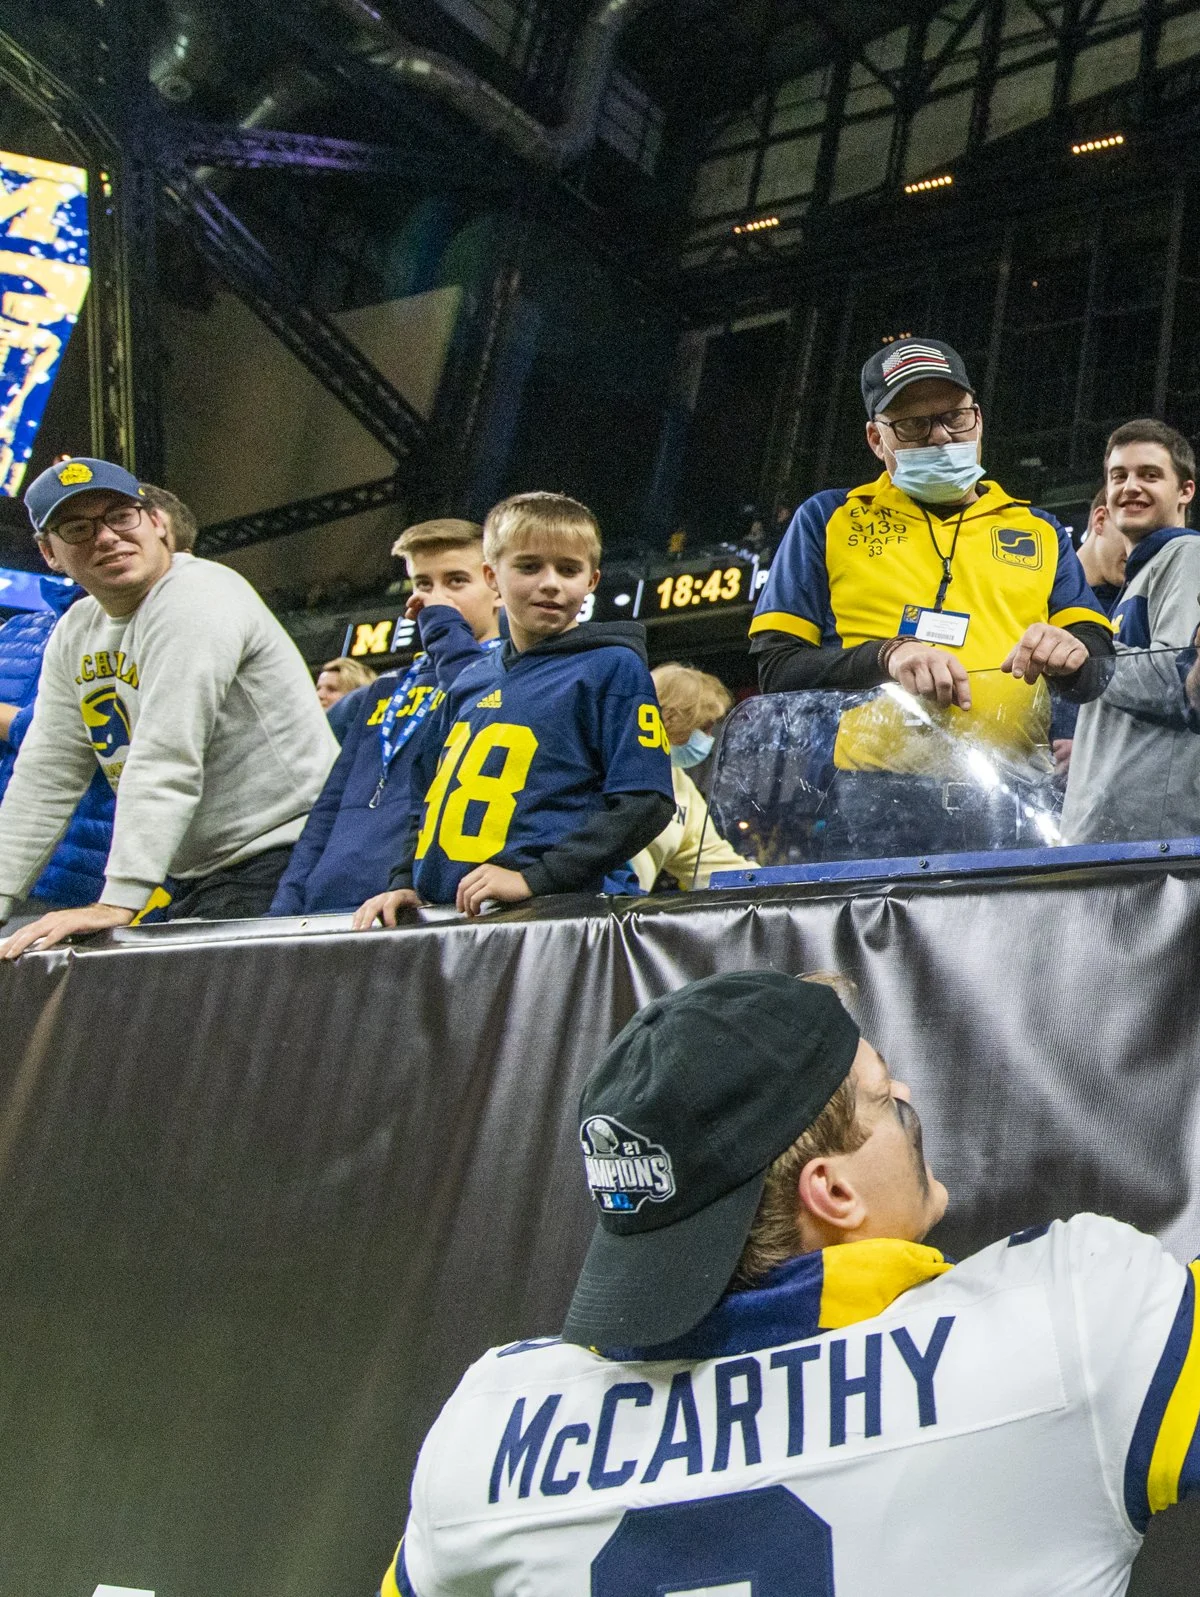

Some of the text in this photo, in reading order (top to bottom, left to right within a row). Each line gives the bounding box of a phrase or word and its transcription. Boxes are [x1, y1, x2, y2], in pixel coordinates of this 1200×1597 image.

[850, 506, 900, 520] EVN
[848, 533, 909, 547] STAFF
[867, 545, 883, 558] 33
[656, 567, 742, 610] 18:43
[351, 620, 393, 657] M
[622, 1140, 641, 1156] 21
[487, 1315, 957, 1505] McCARTHY
